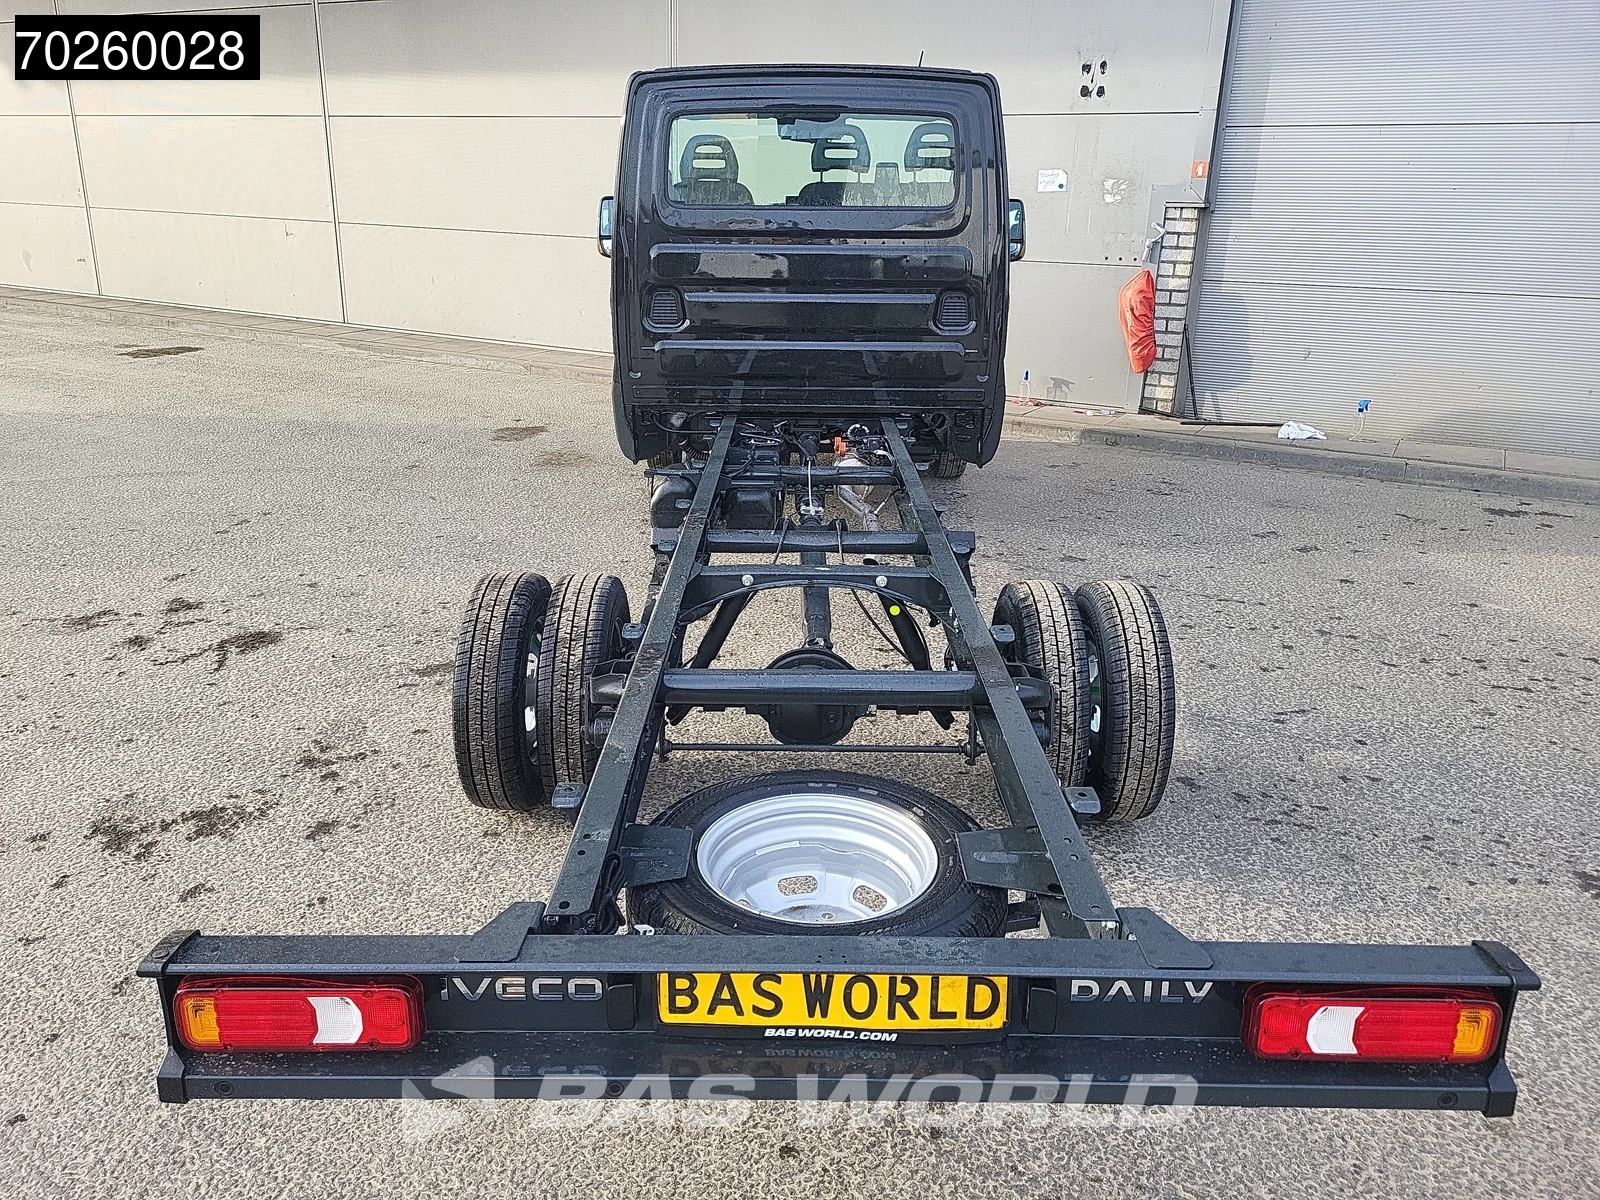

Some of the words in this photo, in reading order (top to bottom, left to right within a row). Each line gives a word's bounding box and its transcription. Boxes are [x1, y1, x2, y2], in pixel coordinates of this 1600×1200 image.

[440, 977, 603, 1001] IVECO
[667, 972, 784, 1018] BAS
[802, 974, 1001, 1021] WORLD
[1070, 979, 1214, 1003] DAILY
